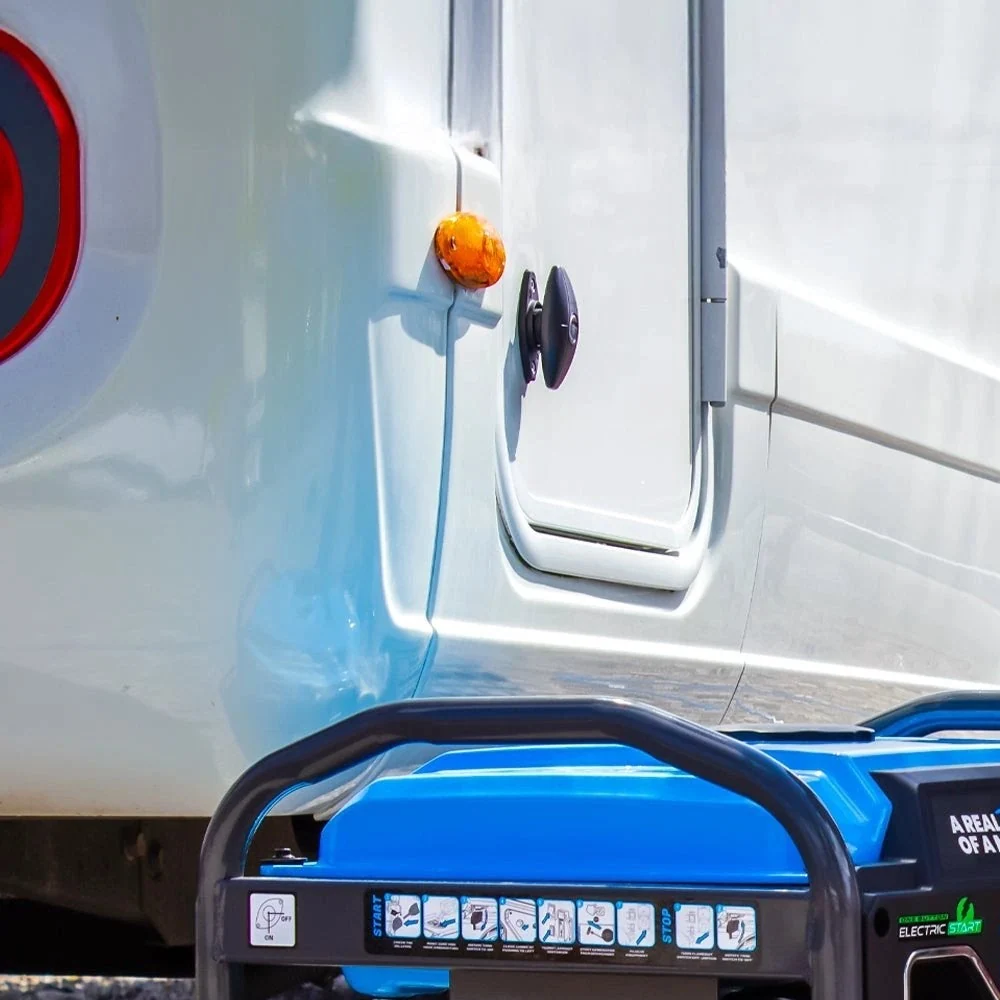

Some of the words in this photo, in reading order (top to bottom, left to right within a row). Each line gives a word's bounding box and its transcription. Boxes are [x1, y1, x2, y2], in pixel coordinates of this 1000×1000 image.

[949, 815, 965, 834] A
[957, 835, 980, 855] OF
[981, 834, 997, 854] A
[280, 915, 292, 923] OFF
[372, 894, 382, 937] START
[661, 907, 672, 944] STOP
[898, 923, 947, 938] ELECTRIC
[948, 920, 982, 935] START
